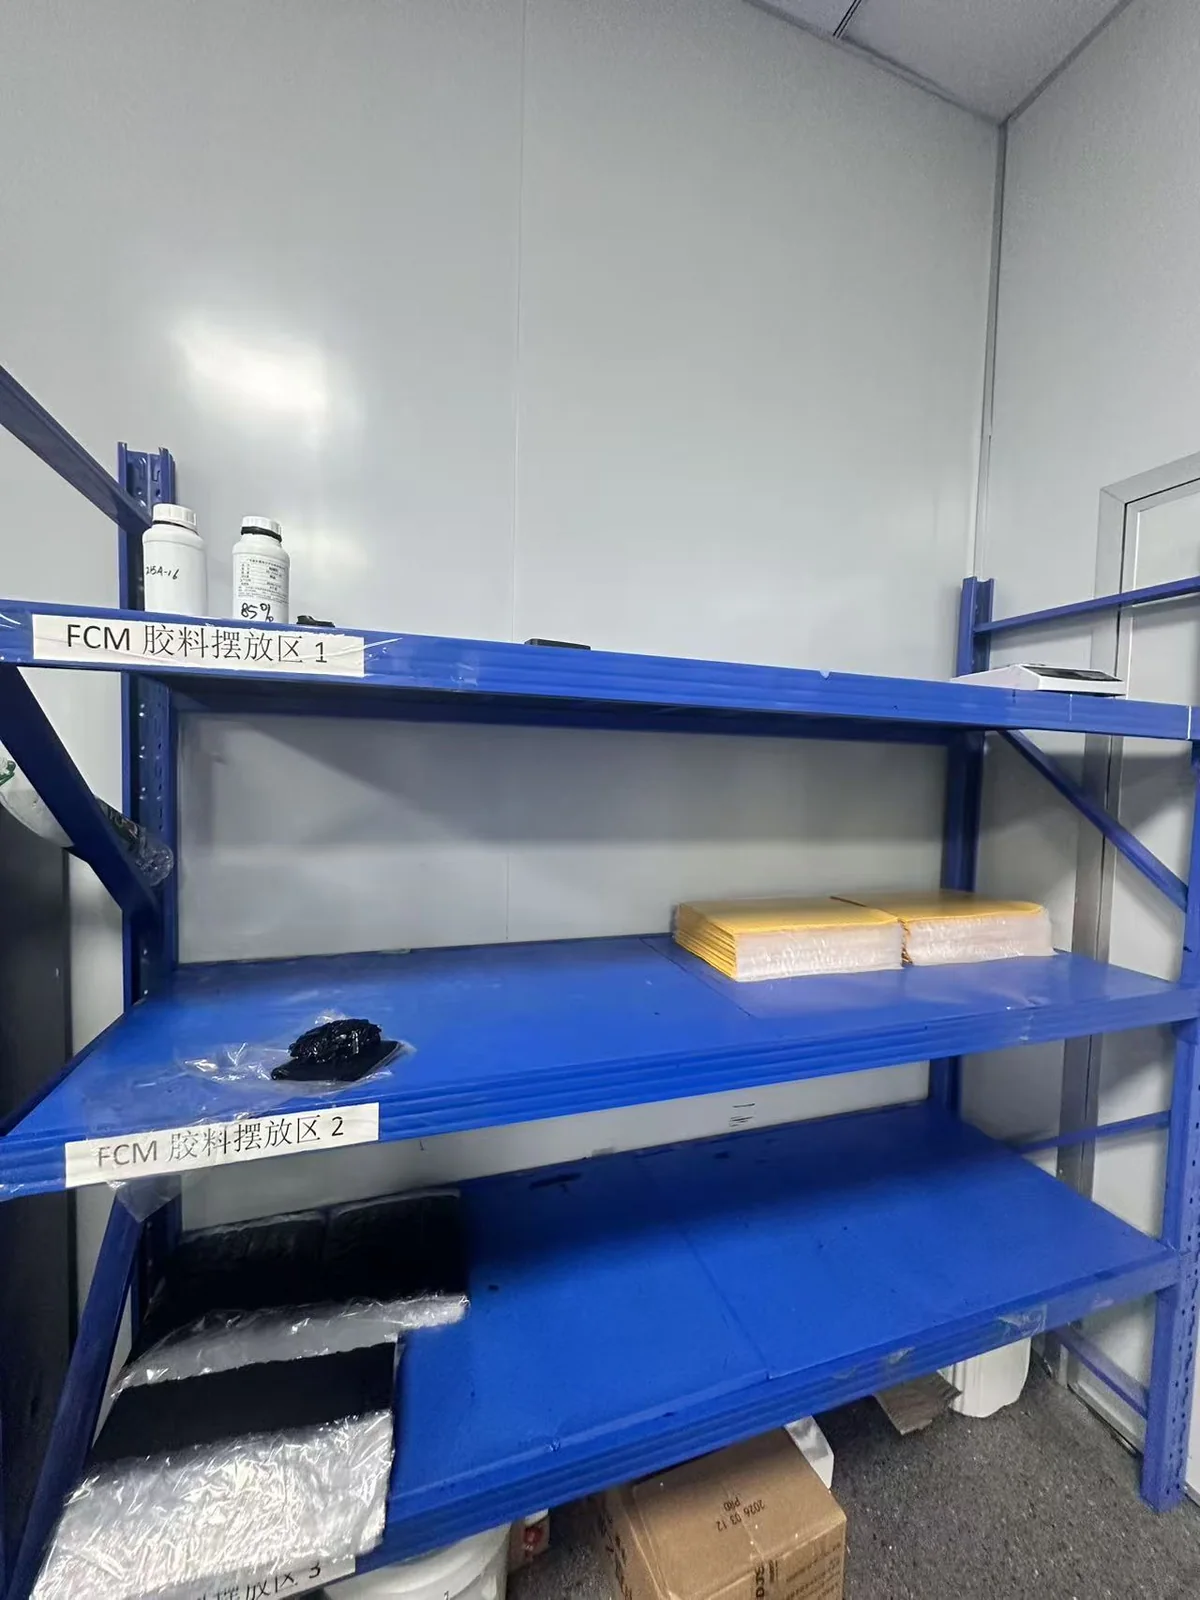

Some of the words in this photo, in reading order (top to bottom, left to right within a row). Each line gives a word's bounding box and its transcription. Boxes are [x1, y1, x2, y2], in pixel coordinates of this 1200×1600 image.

[241, 602, 274, 621] 85%
[66, 624, 130, 651] FCM
[142, 624, 303, 663] 胶料摆放区
[315, 641, 327, 663] 1
[97, 1140, 157, 1168] FCM
[166, 1114, 321, 1162] 胶料摆放区
[331, 1116, 344, 1136] 2
[743, 1499, 765, 1517] 2026
